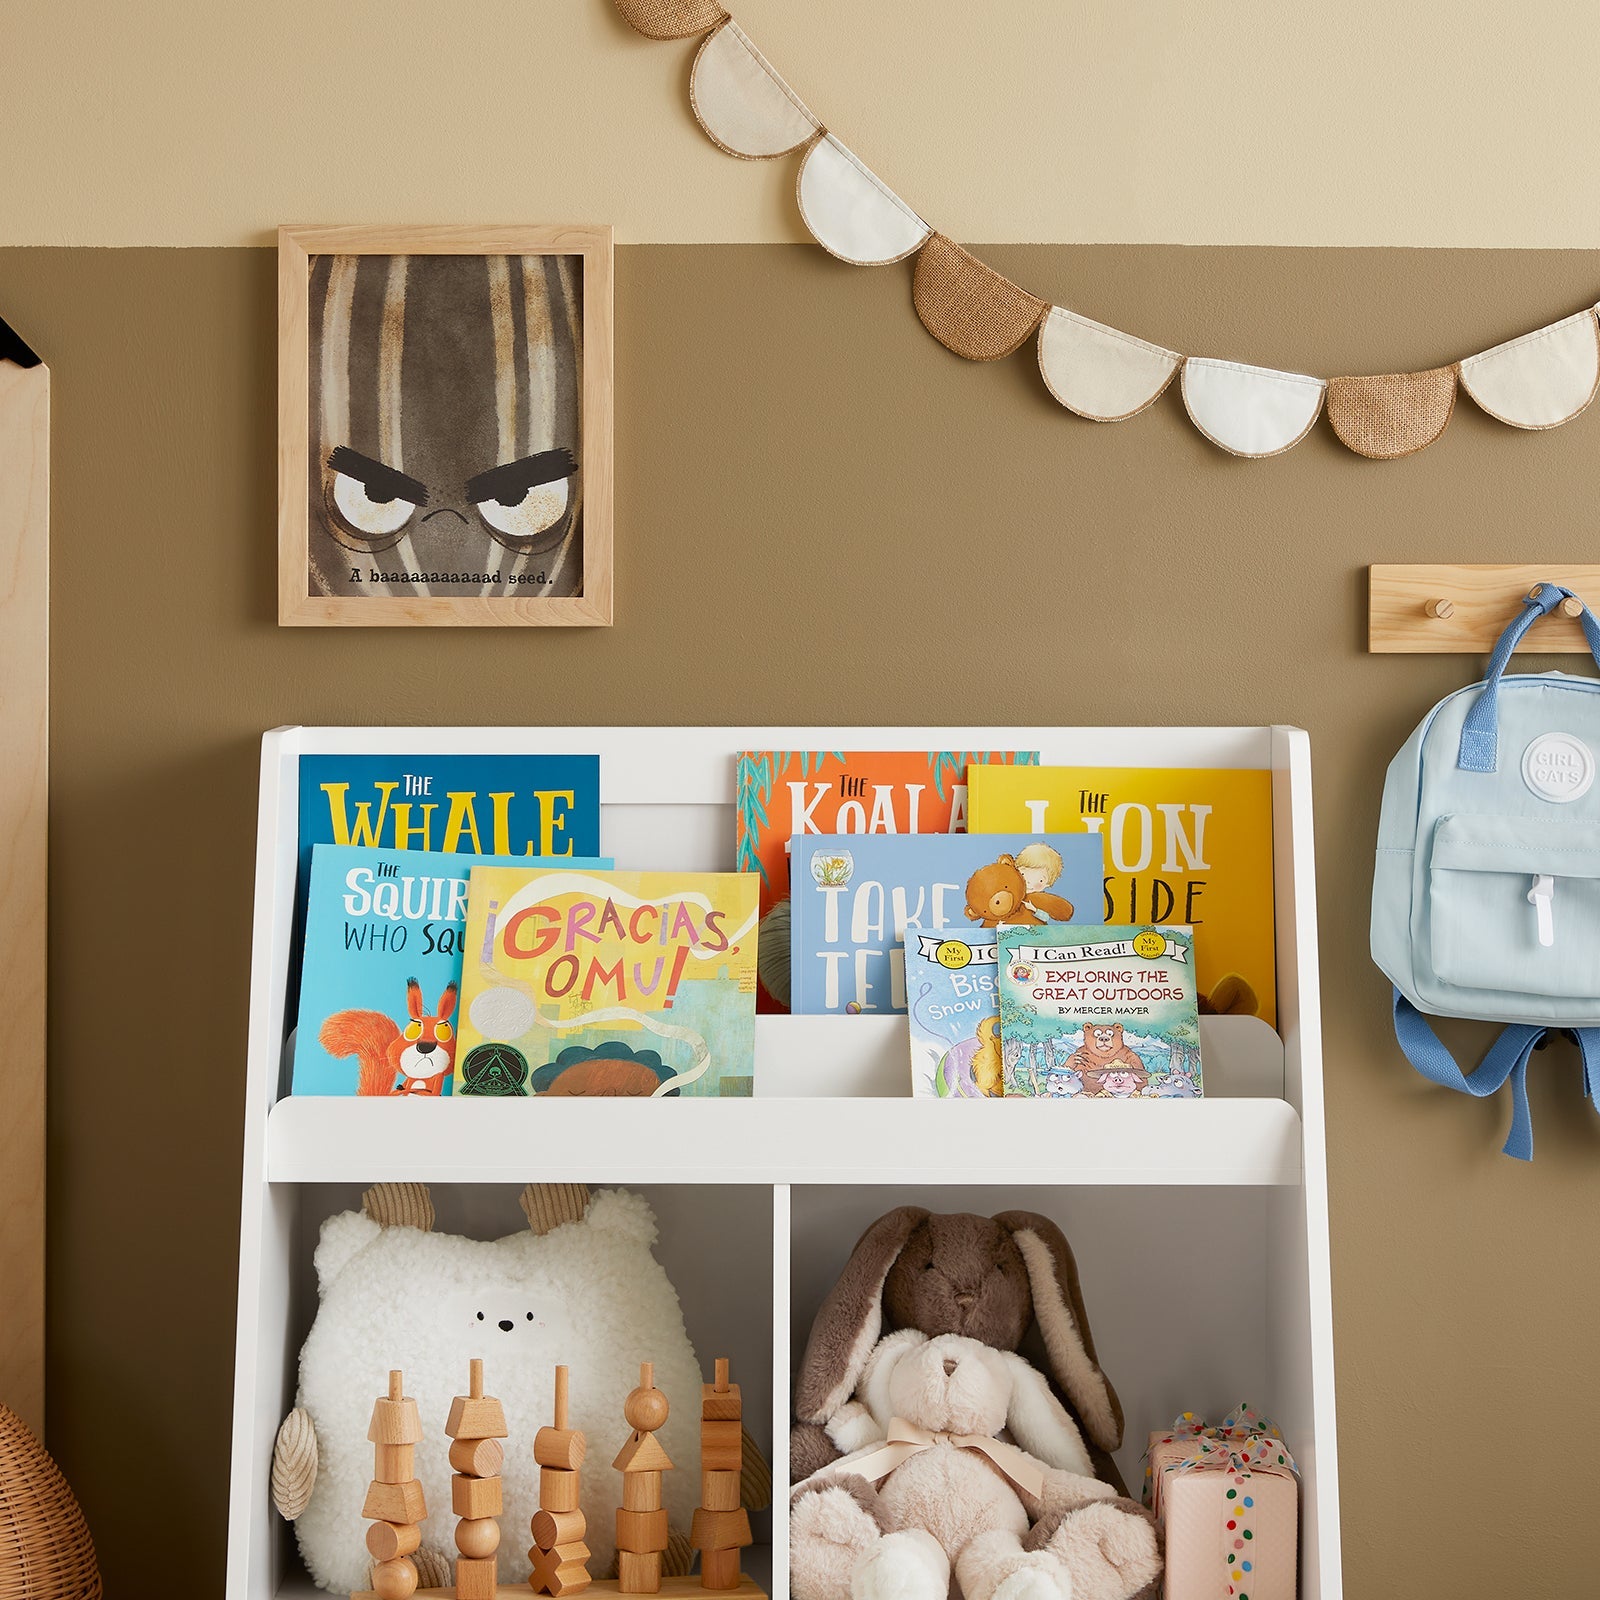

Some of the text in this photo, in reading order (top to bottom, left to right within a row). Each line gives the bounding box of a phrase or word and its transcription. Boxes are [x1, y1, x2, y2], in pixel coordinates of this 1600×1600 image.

[348, 568, 553, 585] A baaaaaaaaaaad seed.
[1536, 752, 1578, 767] GIRL
[1535, 769, 1579, 784] CATS
[402, 774, 433, 797] THE
[839, 774, 868, 798] THE
[1078, 789, 1110, 814] THE
[319, 781, 575, 857] WHALE
[377, 861, 400, 878] THE
[816, 880, 960, 943] TAKE
[345, 921, 407, 953] WHO
[945, 947, 962, 955] My
[977, 948, 984, 960] I
[1033, 948, 1039, 960] I
[1044, 948, 1077, 961] Can
[1080, 943, 1127, 958] Read!
[544, 946, 690, 1008] OMU!
[1045, 970, 1169, 984] EXPLORING THE
[1032, 987, 1184, 1001] GREAT OUTDOORS
[928, 998, 982, 1020] Snow
[1058, 1006, 1149, 1015] BY MERCER MAYER
